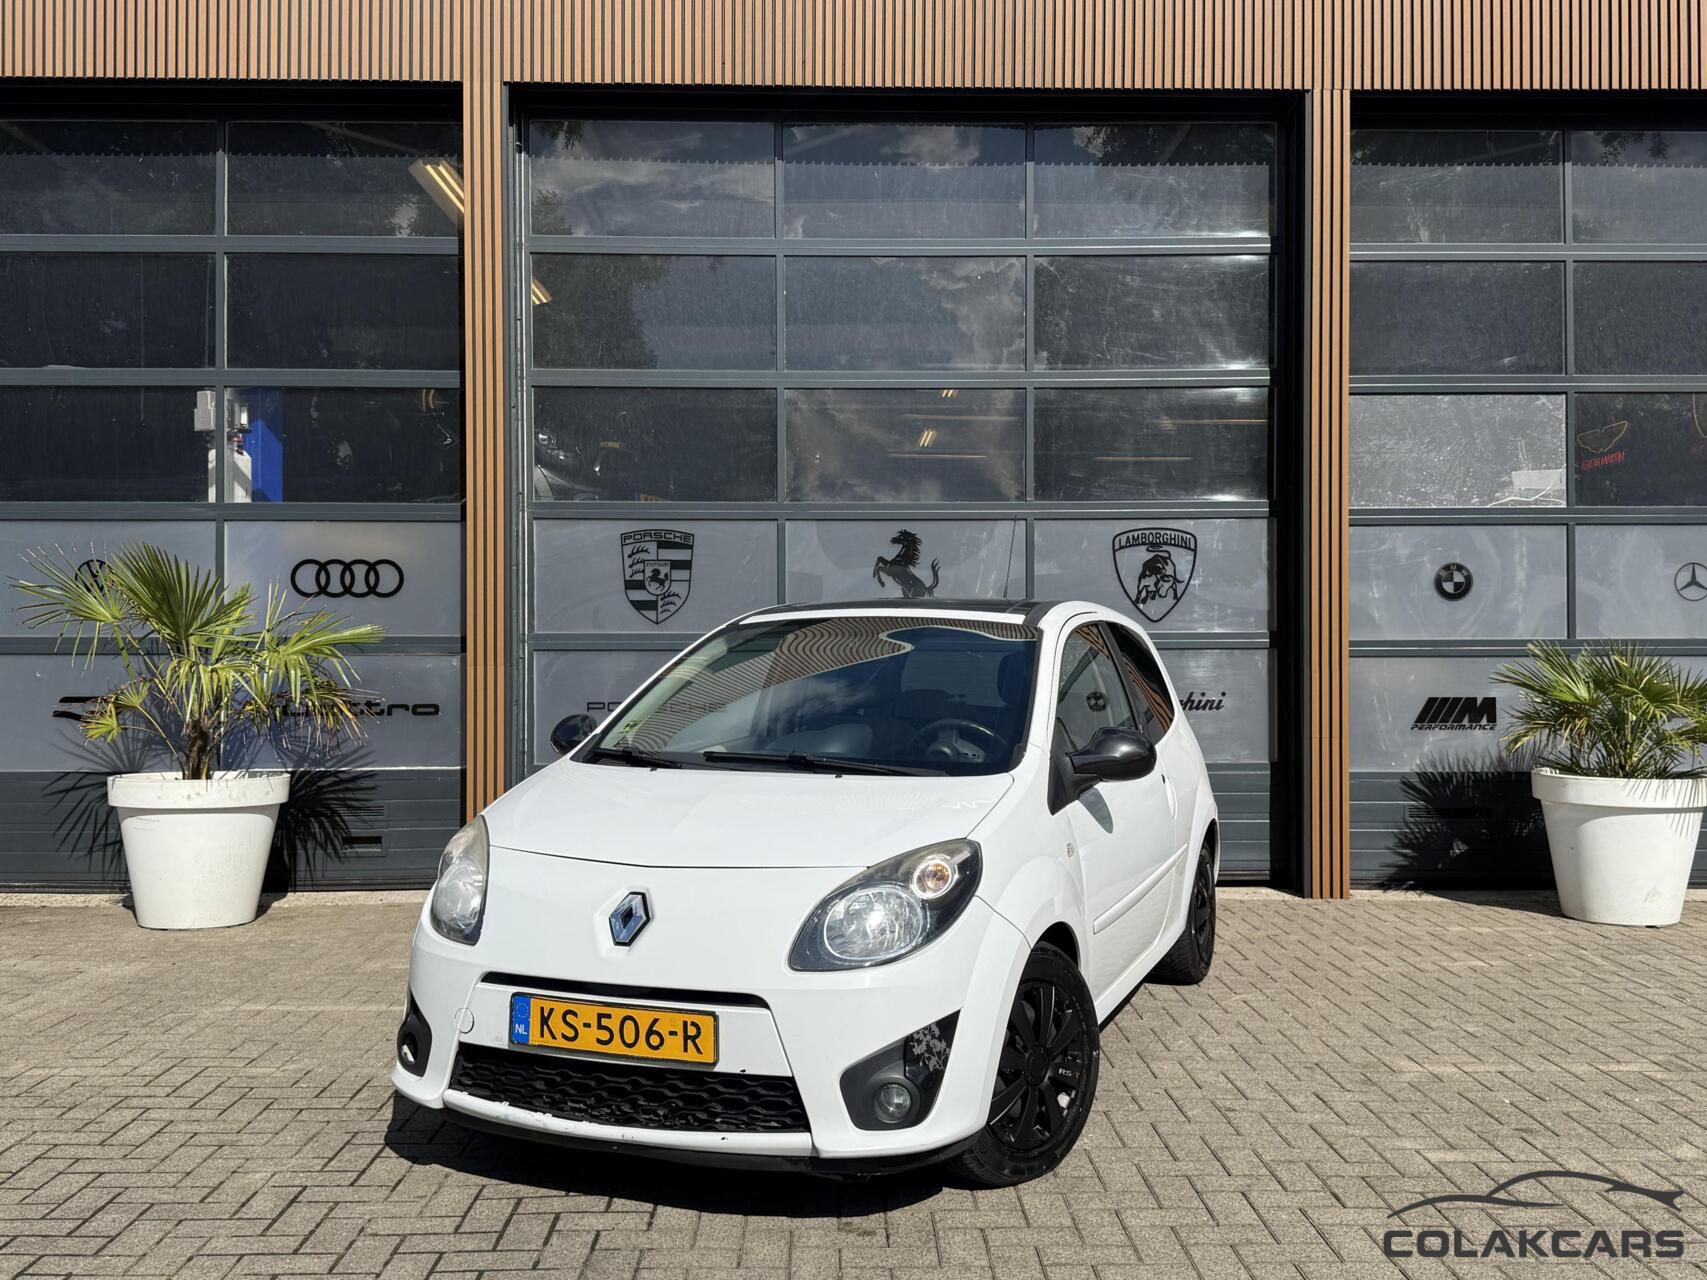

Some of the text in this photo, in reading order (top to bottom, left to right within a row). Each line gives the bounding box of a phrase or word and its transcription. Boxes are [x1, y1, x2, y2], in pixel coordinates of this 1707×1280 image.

[623, 532, 693, 543] PORSCHE
[1118, 531, 1192, 548] LAMBORGHINI
[1410, 723, 1498, 731] PERFORMANCE
[515, 1006, 704, 1055] NL KS-506-R
